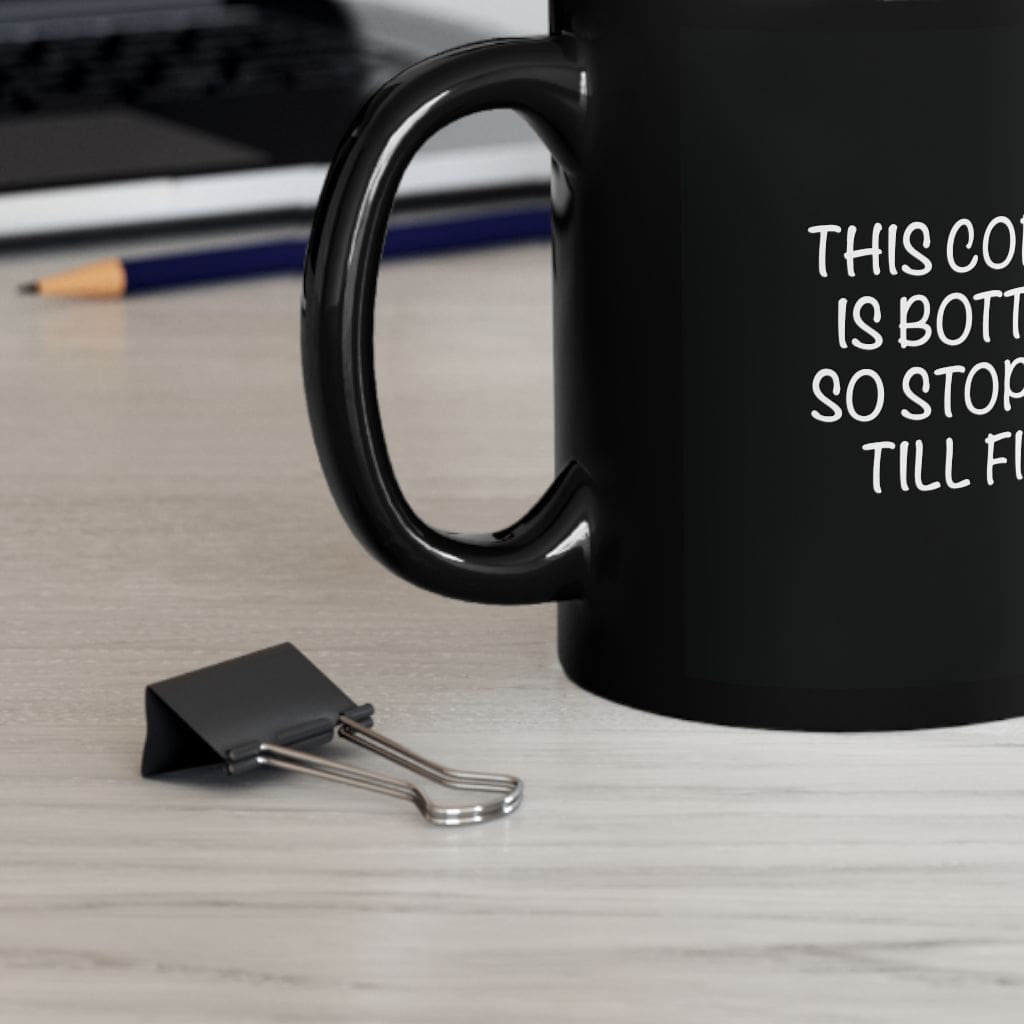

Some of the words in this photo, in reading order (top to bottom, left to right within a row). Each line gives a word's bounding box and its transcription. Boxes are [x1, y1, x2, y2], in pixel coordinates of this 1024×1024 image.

[807, 222, 933, 277] THIS
[837, 295, 884, 351] IS
[810, 368, 885, 423] SO
[861, 436, 971, 494] TILL
